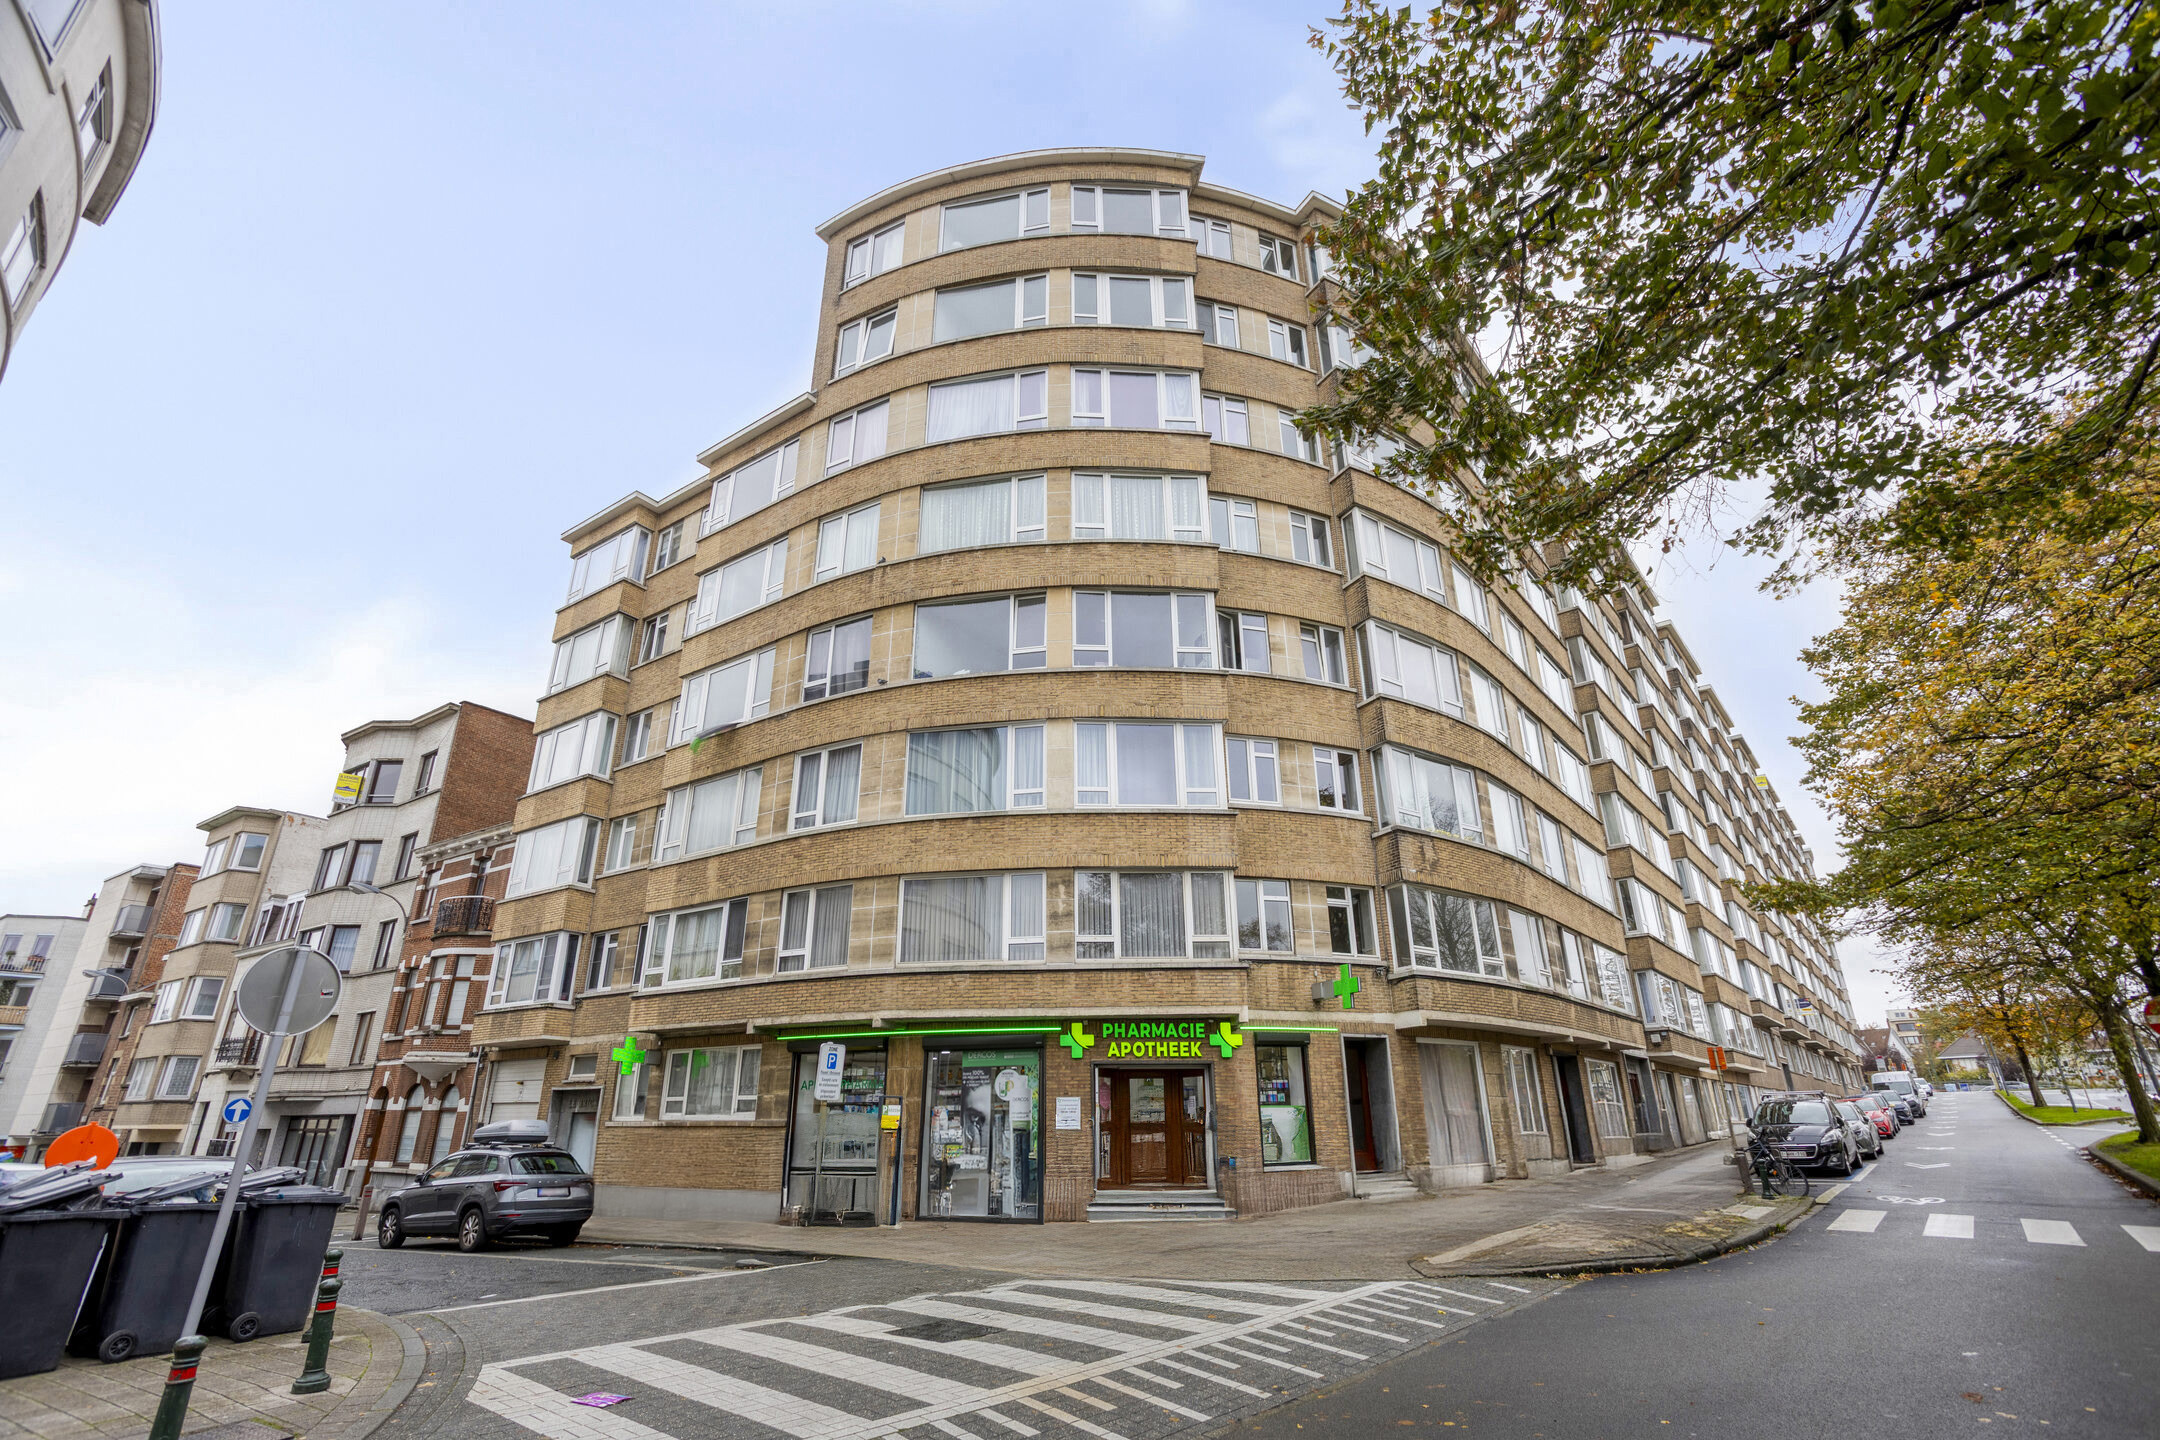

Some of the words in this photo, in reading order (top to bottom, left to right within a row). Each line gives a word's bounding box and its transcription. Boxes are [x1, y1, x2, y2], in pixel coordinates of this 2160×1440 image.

[1102, 1023, 1206, 1038] PHARMACIE
[1107, 1041, 1202, 1057] APOTHEEK
[827, 1054, 836, 1068] P
